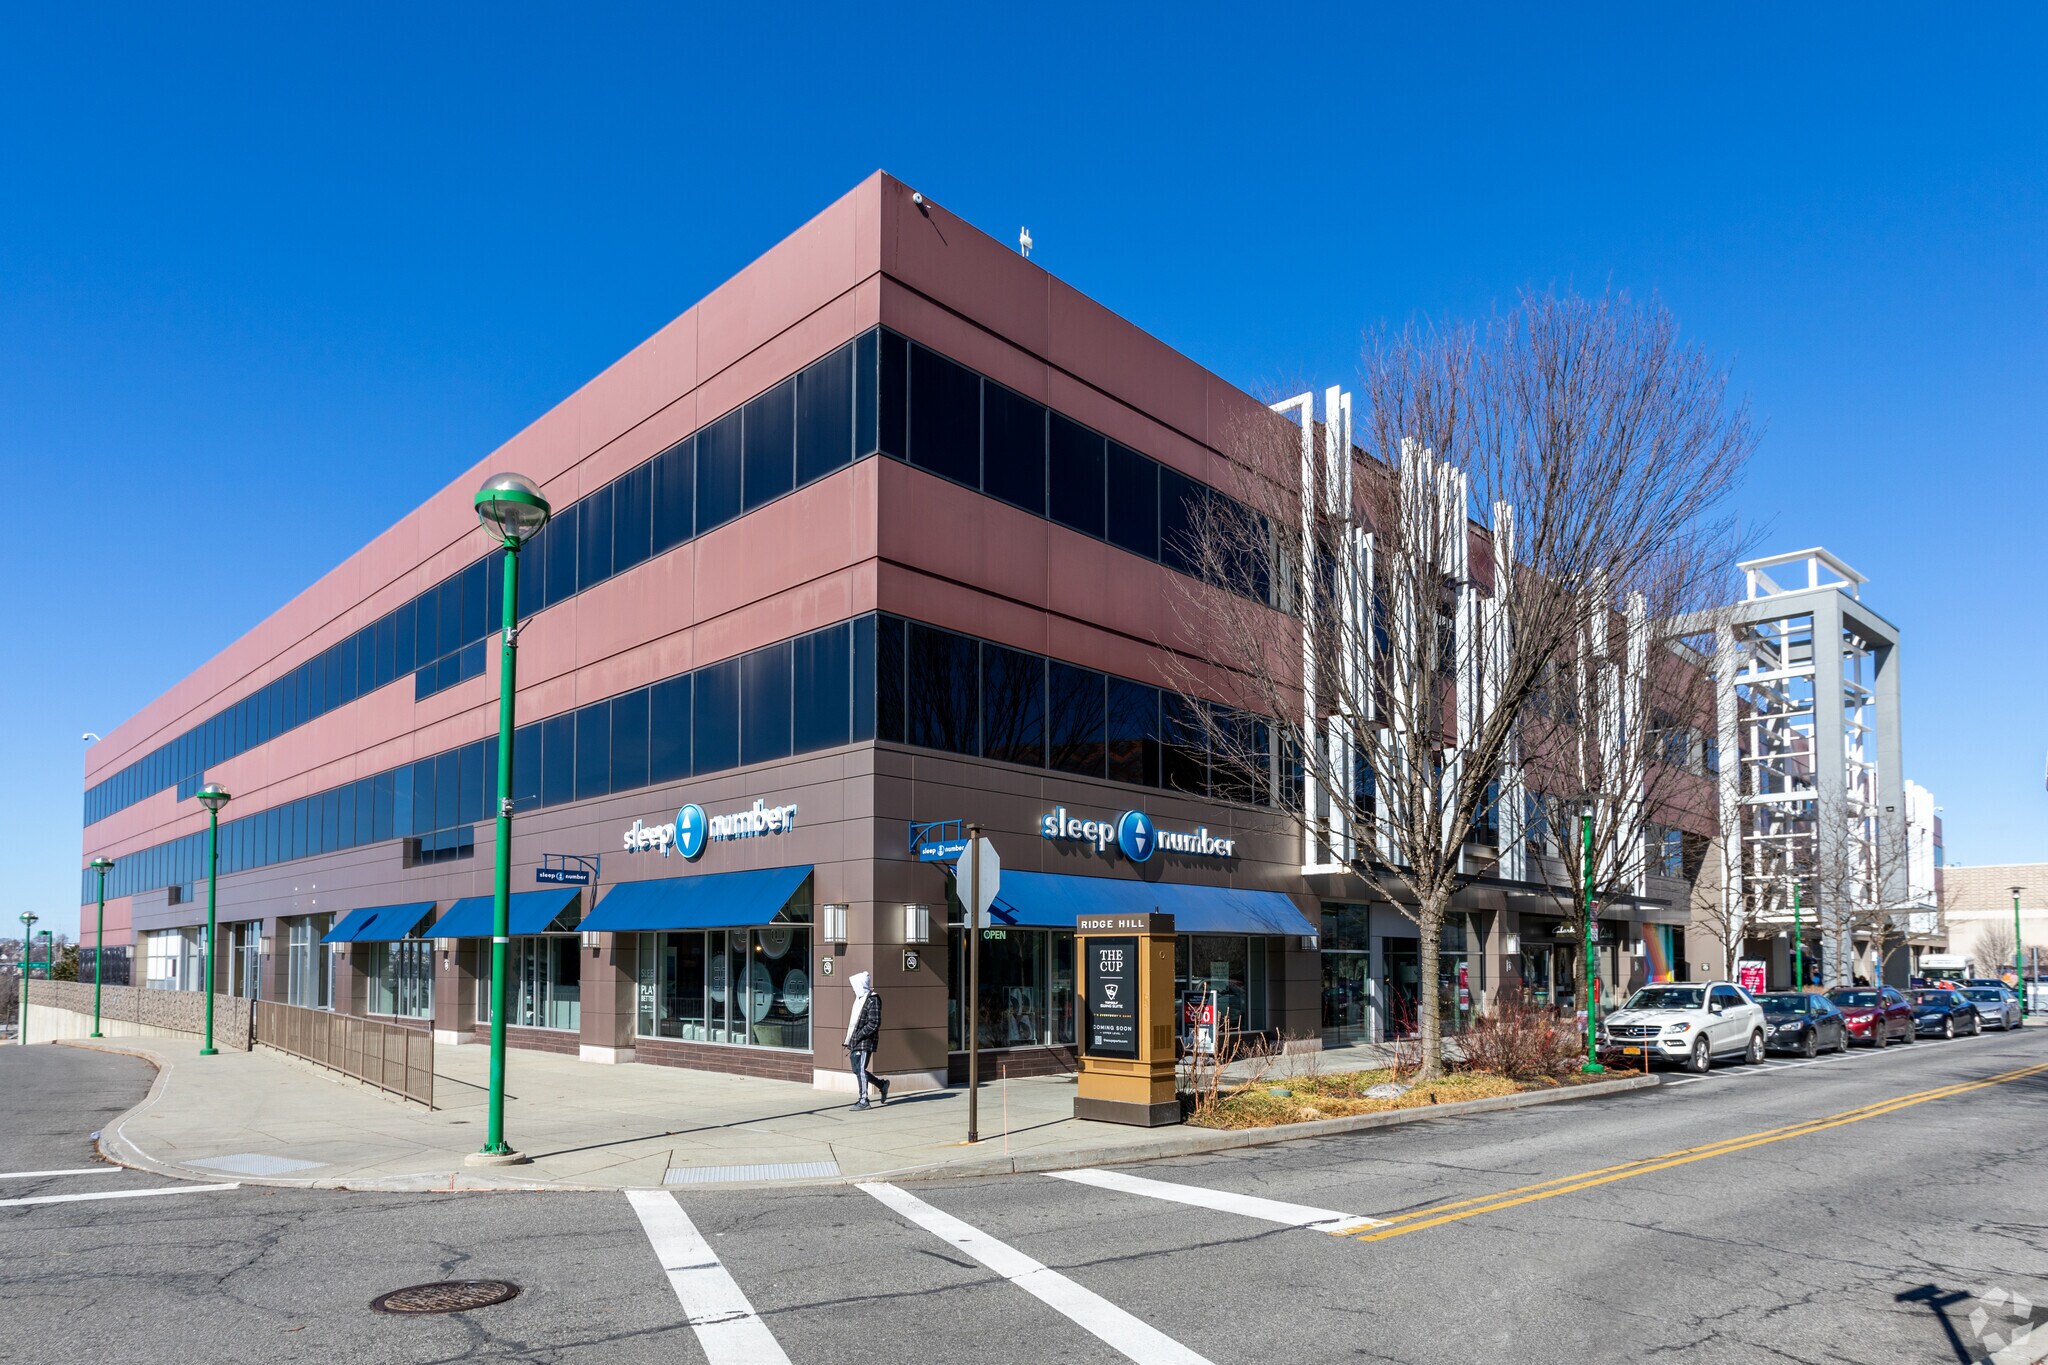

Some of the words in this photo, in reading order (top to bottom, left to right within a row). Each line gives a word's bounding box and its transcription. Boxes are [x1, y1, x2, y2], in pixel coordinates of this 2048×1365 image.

[623, 819, 676, 858] sleep
[709, 799, 798, 842] number
[1041, 806, 1115, 853] sleep
[1155, 826, 1236, 857] number
[1081, 920, 1113, 929] RIDGE
[1118, 919, 1144, 928] HILL
[1552, 925, 1576, 933] Clark
[983, 930, 1006, 939] OPEN
[1100, 950, 1123, 960] THE
[1100, 961, 1123, 972] CUP
